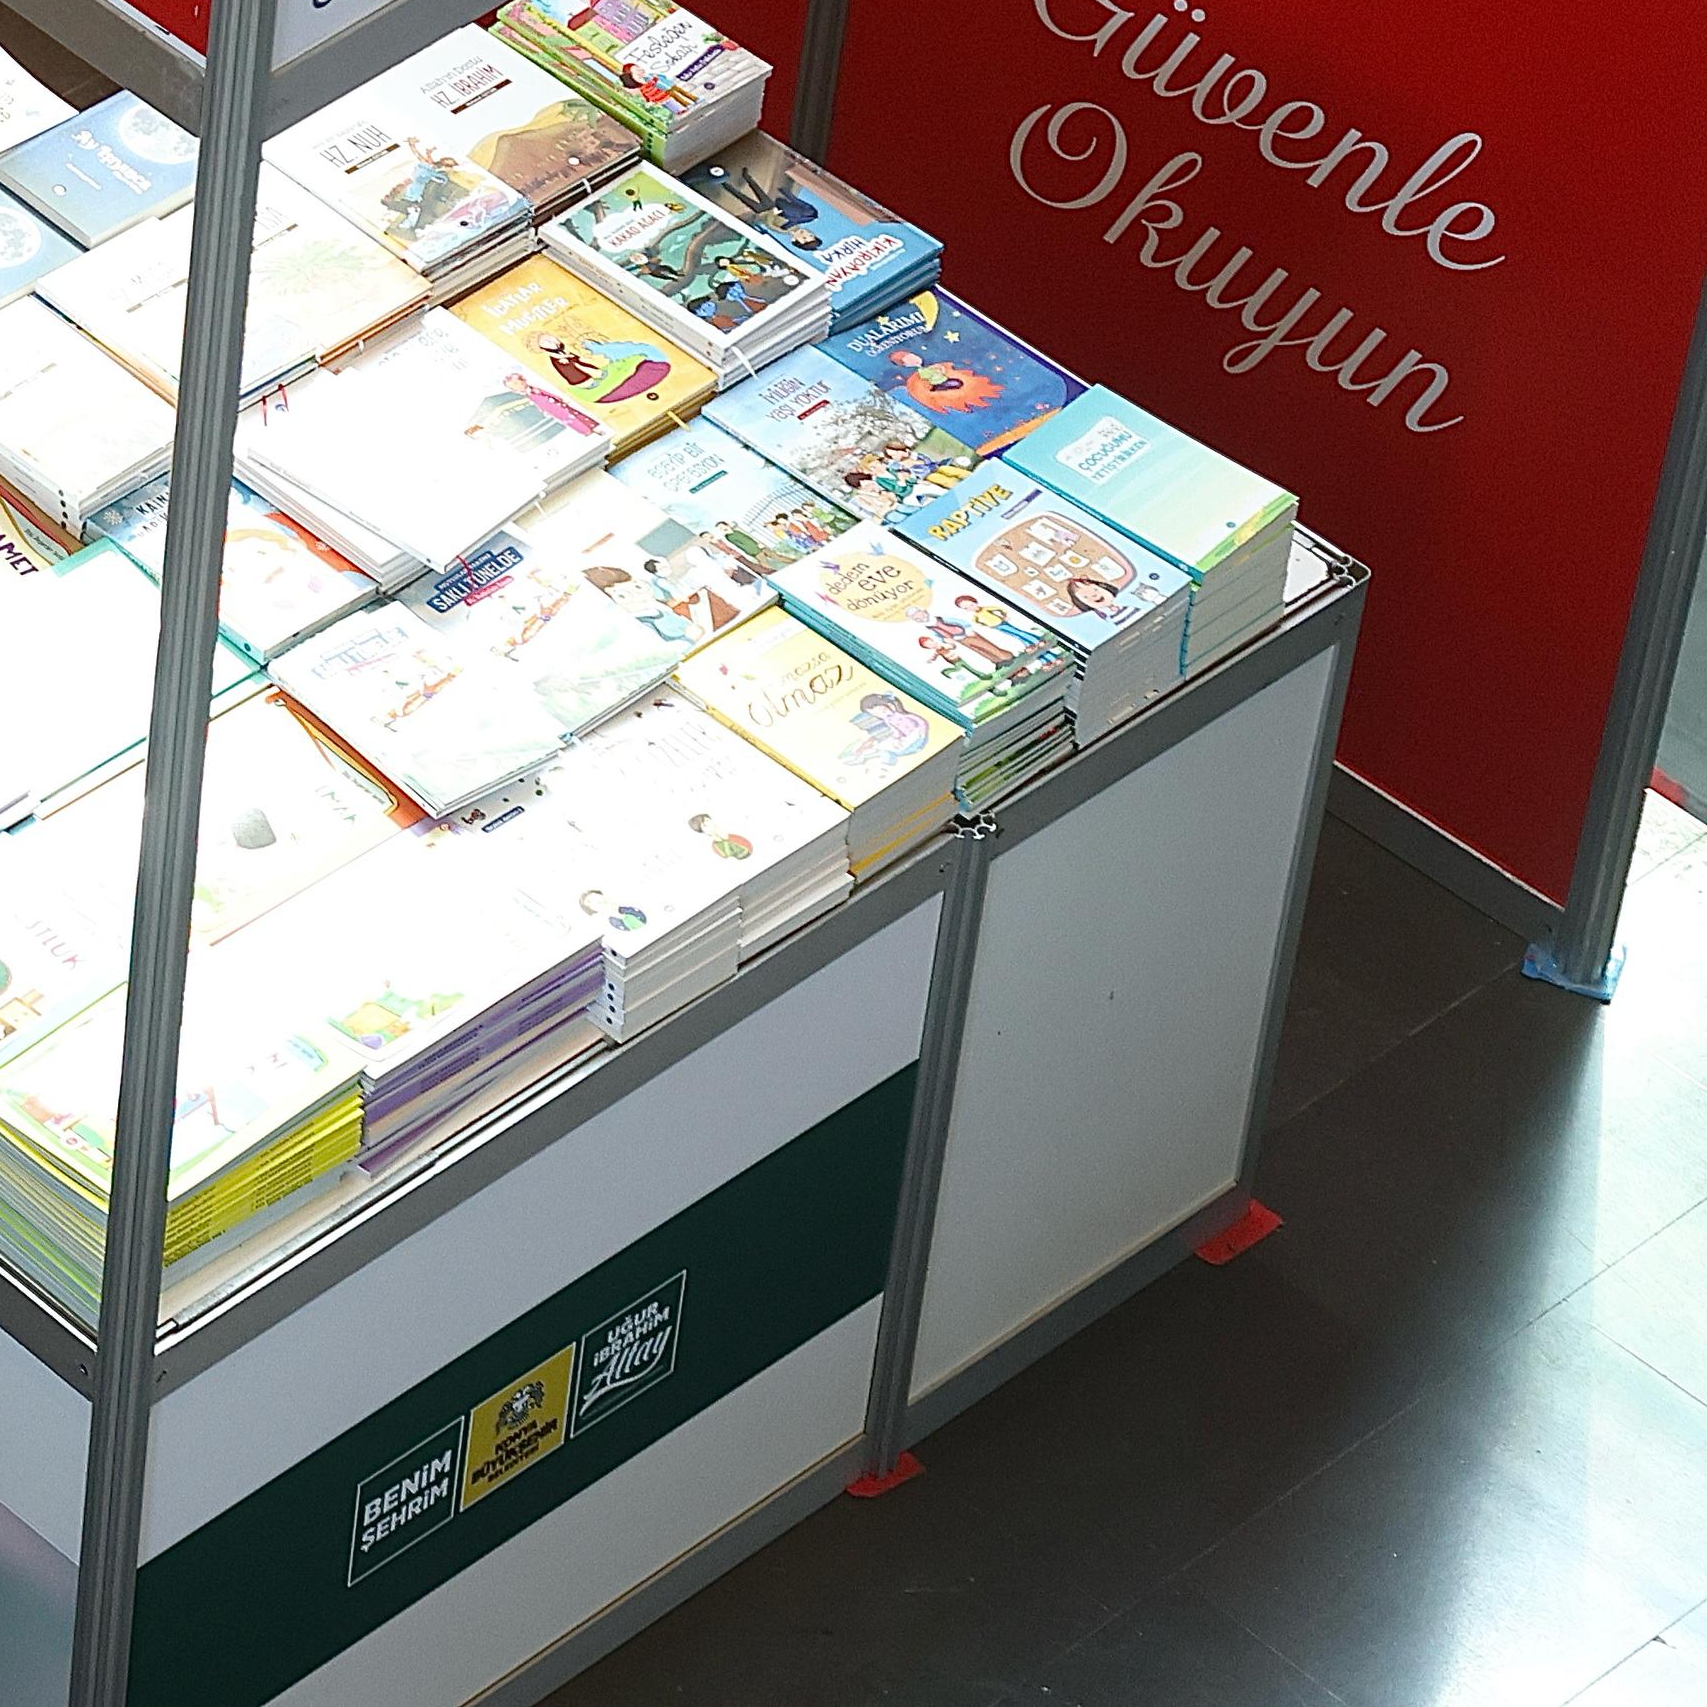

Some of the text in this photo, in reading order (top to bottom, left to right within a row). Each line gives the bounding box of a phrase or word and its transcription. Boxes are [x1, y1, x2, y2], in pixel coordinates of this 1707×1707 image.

[453, 61, 506, 106] İBRAHİM
[352, 125, 394, 160] NUH
[1009, 102, 1464, 434] Okuyun
[1076, 428, 1134, 473] ÇOCUĞUMU
[433, 581, 473, 613] SAKLI
[469, 549, 523, 593] TÜNELDE
[826, 564, 872, 597] dedem
[845, 576, 917, 612] dönüyor
[858, 562, 903, 598] eve
[593, 1306, 670, 1367] İBRAHİM
[607, 1300, 660, 1344] UĞUR
[580, 1325, 673, 1418] Altay
[364, 1449, 453, 1527] BENİM
[360, 1477, 449, 1554] ŞEHRİM
